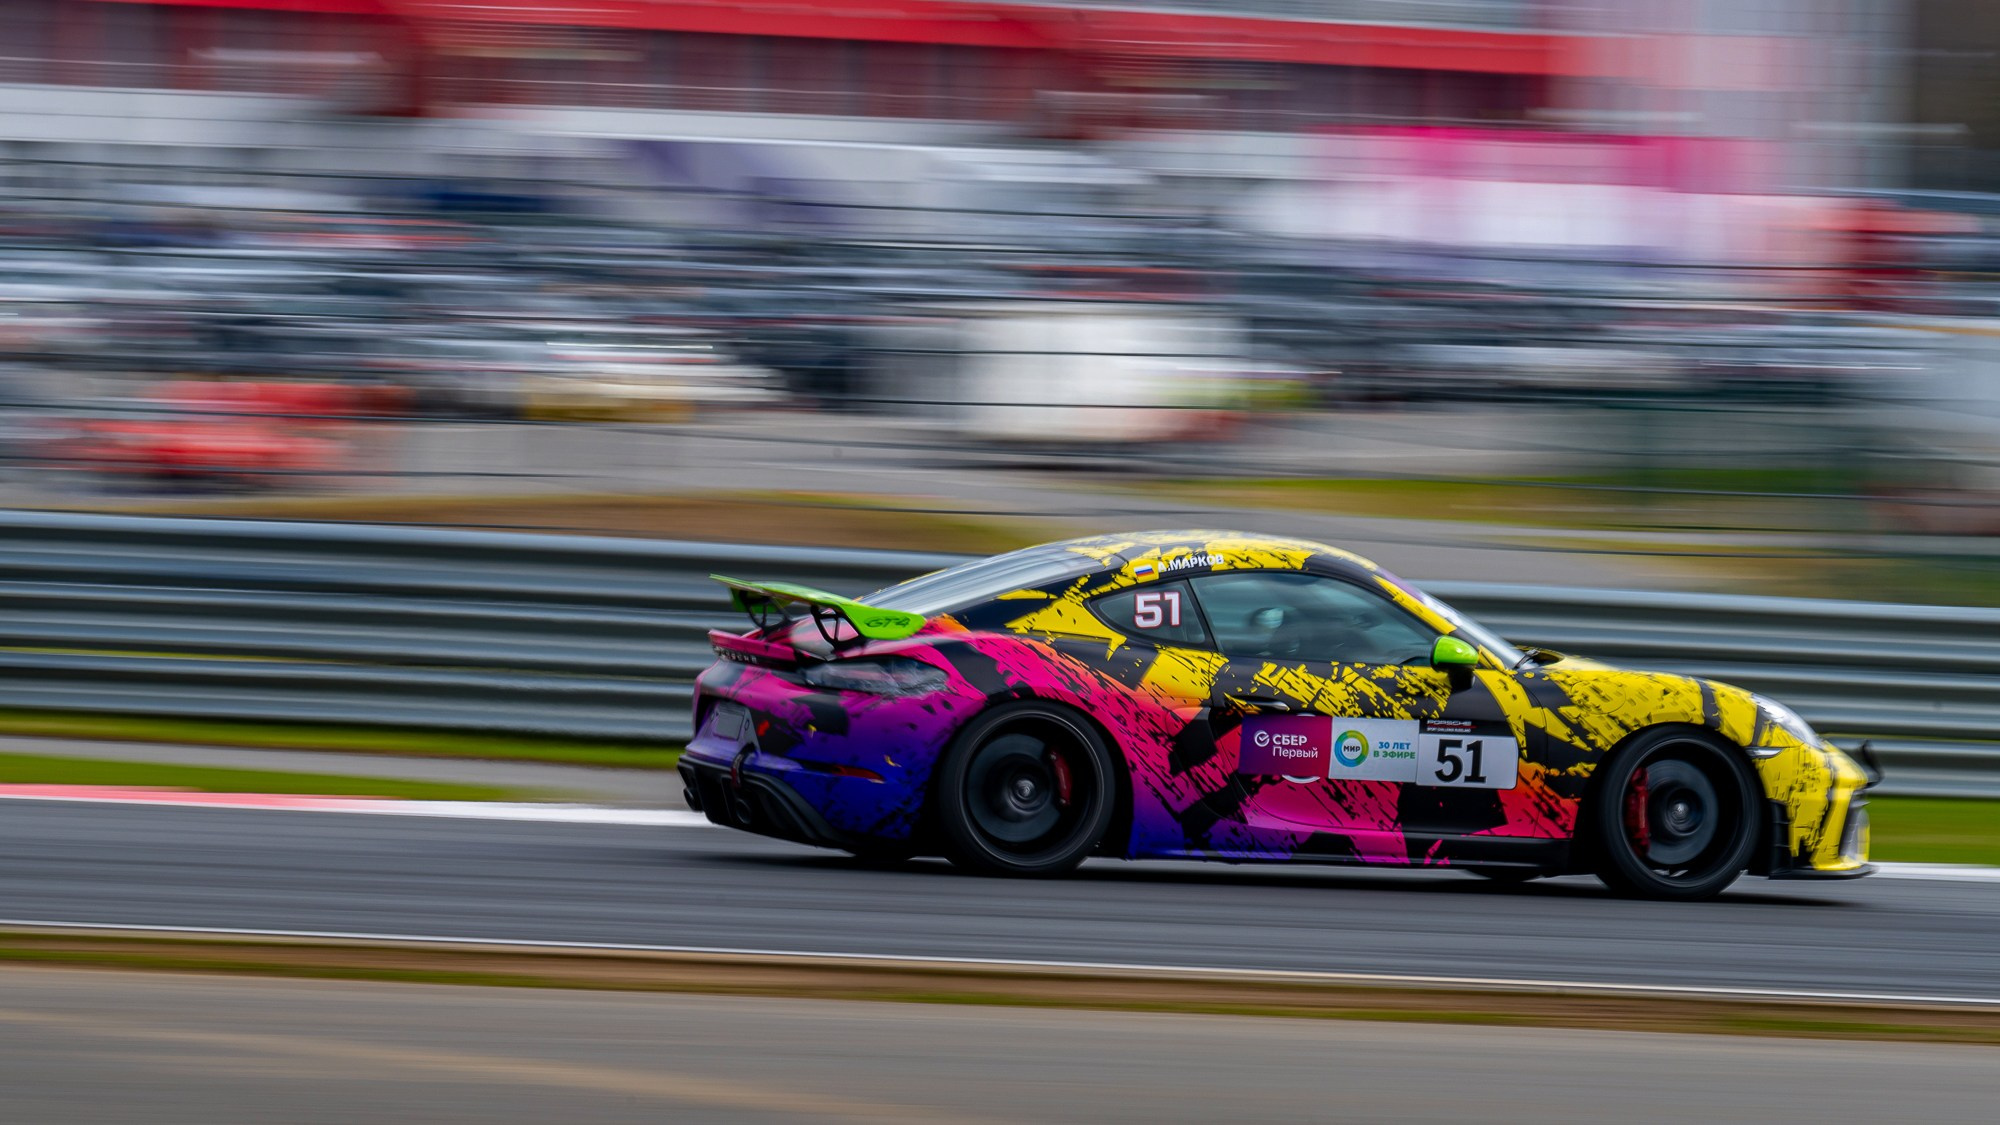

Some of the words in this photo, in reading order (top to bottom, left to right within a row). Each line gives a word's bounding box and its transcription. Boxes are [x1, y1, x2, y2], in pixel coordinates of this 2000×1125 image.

[1158, 554, 1224, 573] А.МАРКОВ
[1134, 591, 1181, 628] 51
[864, 616, 910, 628] GT4
[1272, 734, 1308, 746] СБЕР
[1378, 741, 1390, 750] 30
[1392, 742, 1411, 750] ЛЕТ
[1272, 746, 1319, 759] Первый
[1382, 751, 1416, 759] ЭФИРЕ
[1435, 739, 1486, 783] 51
